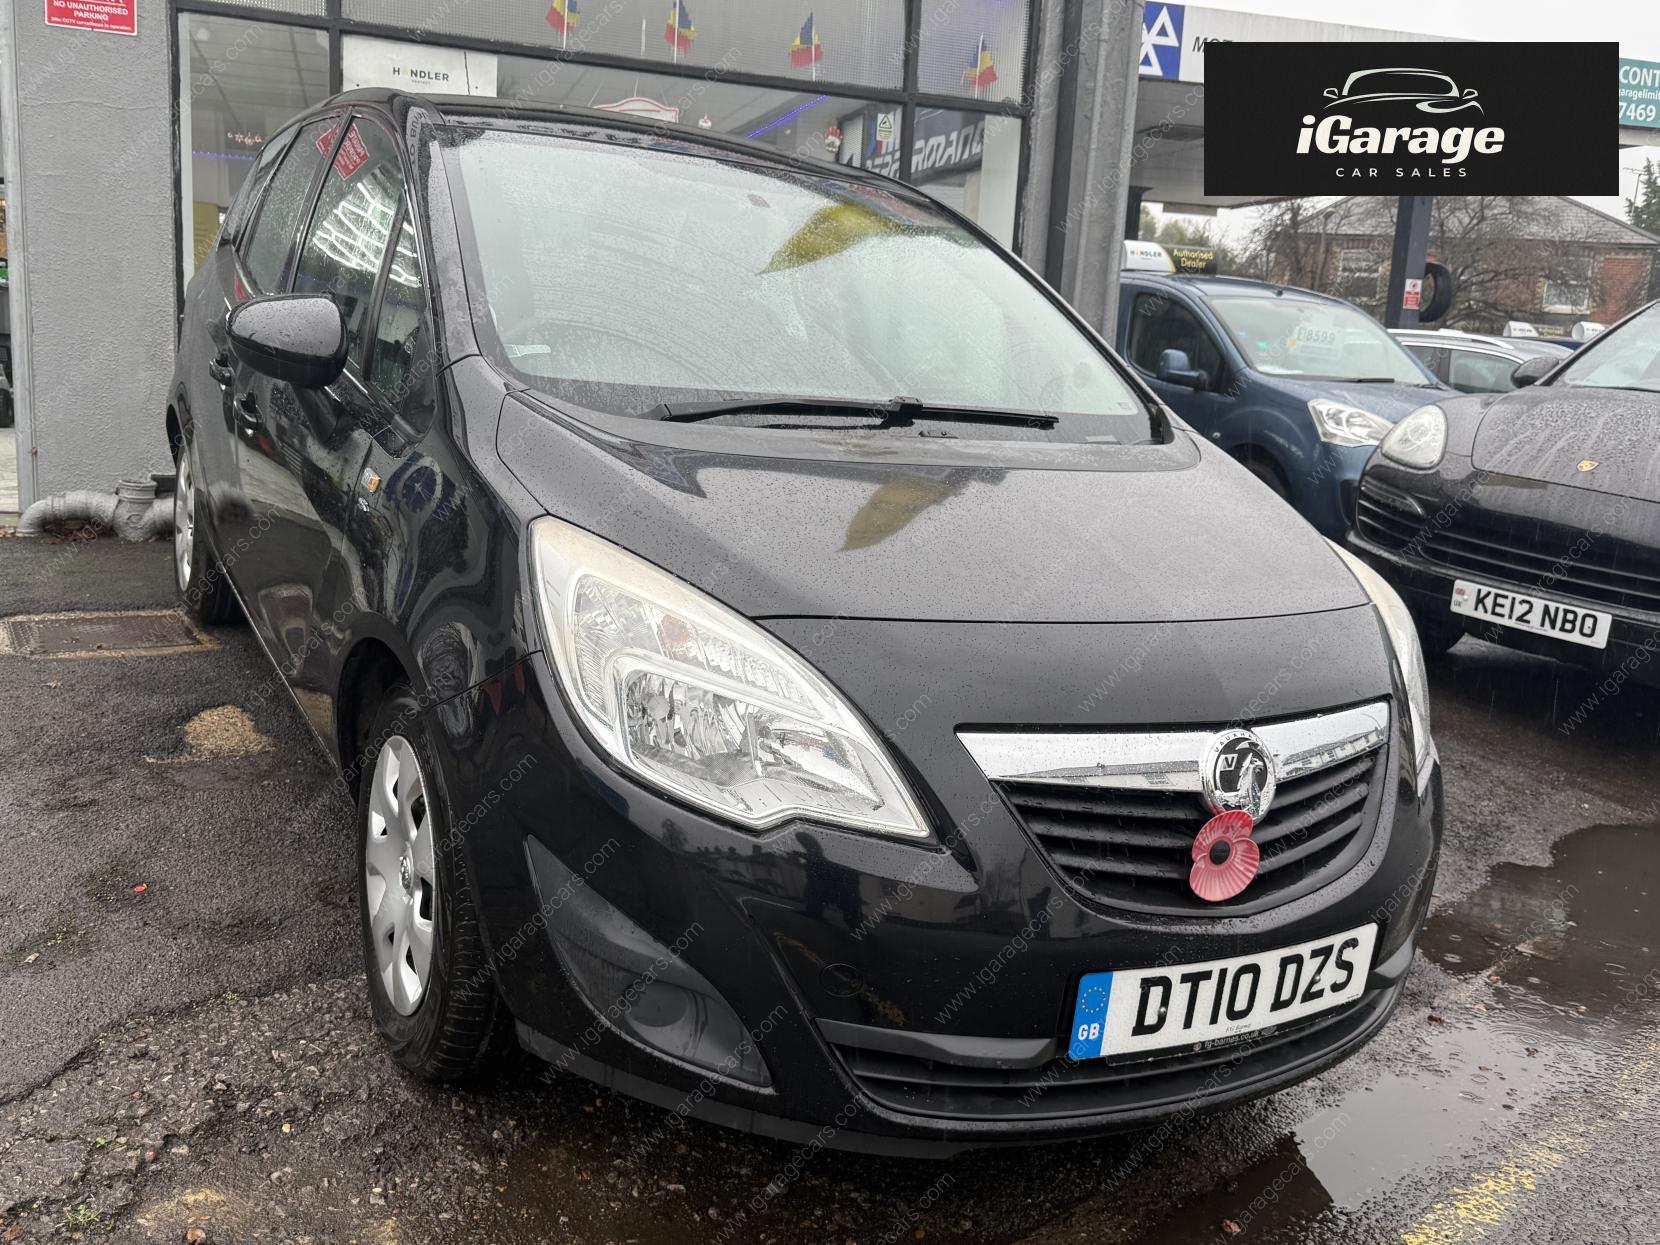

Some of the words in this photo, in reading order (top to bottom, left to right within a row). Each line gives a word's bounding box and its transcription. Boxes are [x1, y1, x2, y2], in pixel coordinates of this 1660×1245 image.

[54, 0, 65, 8] NO
[66, 2, 129, 16] UNAUTHORISED
[74, 10, 109, 20] PARKING
[1173, 248, 1214, 260] Authorised
[1180, 258, 1207, 268] Dealer
[1474, 588, 1534, 625] KE12
[1540, 604, 1598, 638] NBO
[1130, 962, 1261, 1037] DT10
[1270, 937, 1359, 1013] DZS
[1078, 1022, 1101, 1041] GB
